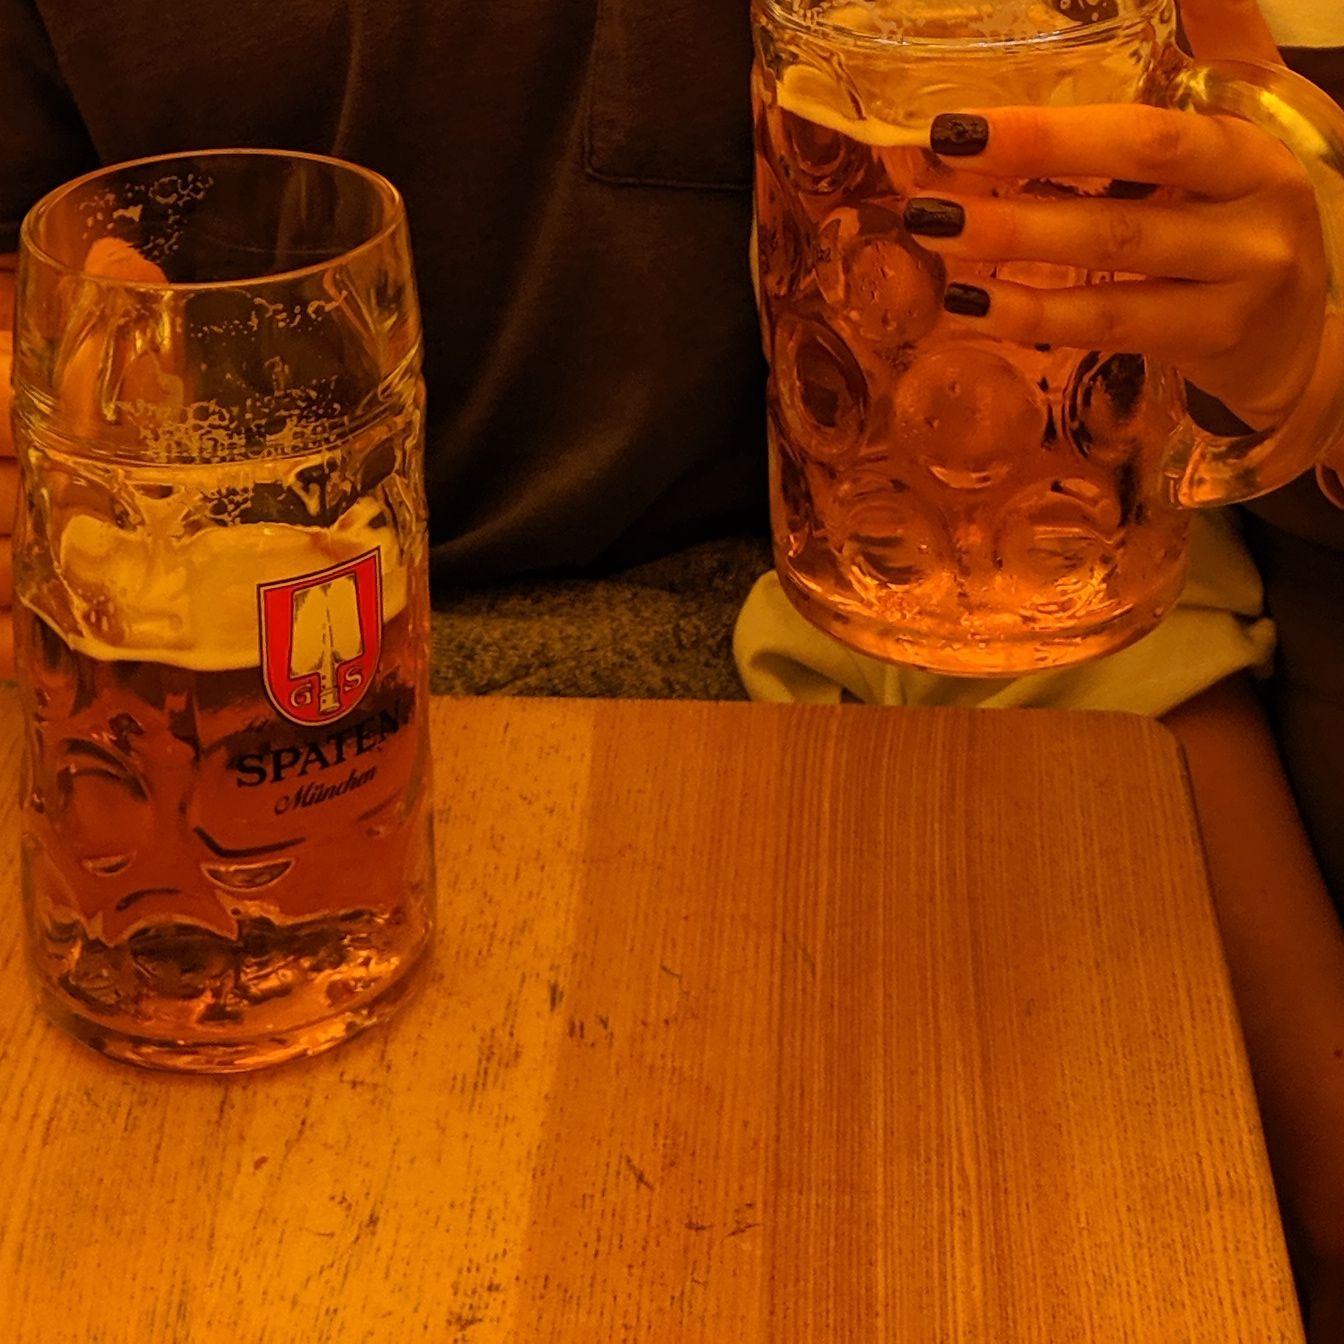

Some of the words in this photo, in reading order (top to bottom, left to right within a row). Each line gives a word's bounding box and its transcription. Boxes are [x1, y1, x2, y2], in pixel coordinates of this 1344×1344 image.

[289, 682, 312, 707] G
[343, 667, 363, 691] S
[237, 709, 400, 787] SPATEN
[274, 764, 377, 814] München
